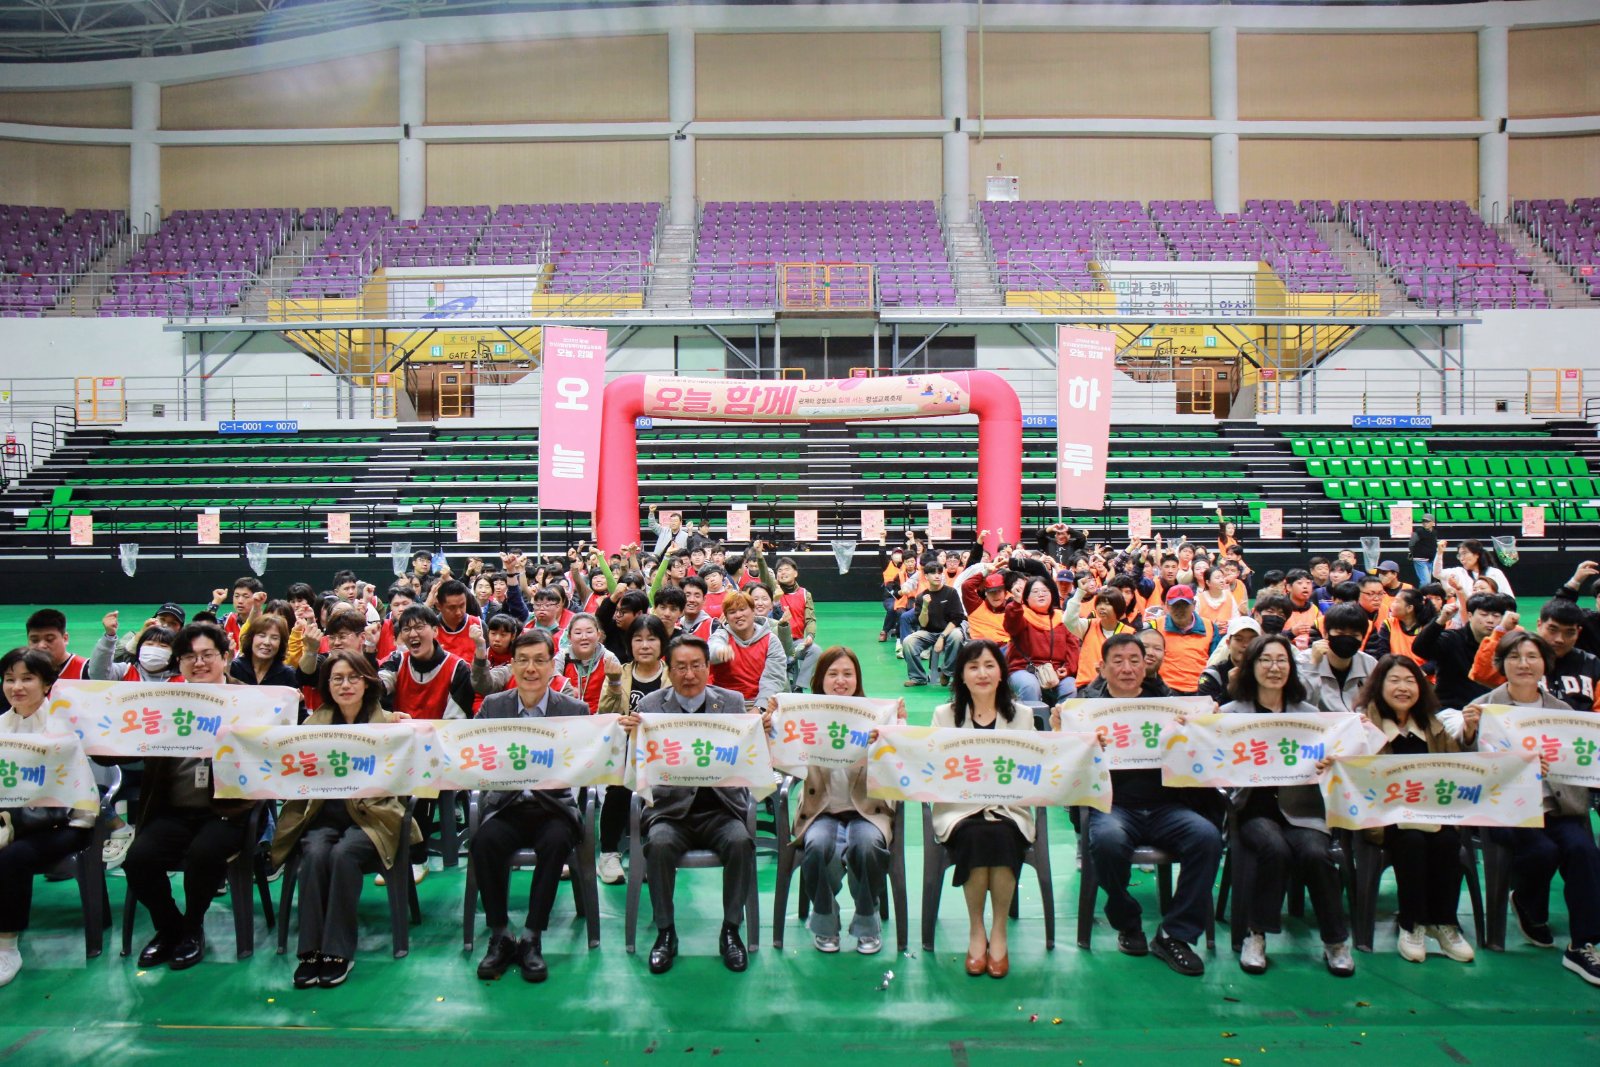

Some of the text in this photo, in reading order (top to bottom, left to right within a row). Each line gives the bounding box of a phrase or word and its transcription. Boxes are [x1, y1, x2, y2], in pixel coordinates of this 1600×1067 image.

[448, 352, 469, 360] GATE
[1180, 345, 1198, 355] 2-4
[652, 385, 798, 416] 오늘, 함께
[220, 422, 262, 431] C-1-0001
[276, 422, 297, 430] 0070
[1354, 417, 1396, 426] C-1-0251
[1410, 417, 1431, 426] 0320
[172, 708, 222, 736] 함께
[827, 720, 870, 750] 함께
[1140, 720, 1162, 749] 함
[326, 749, 376, 778] 함께
[506, 742, 554, 771] 함께
[691, 738, 739, 768] 함께
[1277, 737, 1324, 766] 함께
[1572, 736, 1600, 766] 함
[0, 758, 46, 788] 함께
[992, 756, 1042, 785] 함께
[1434, 778, 1482, 806] 함께
